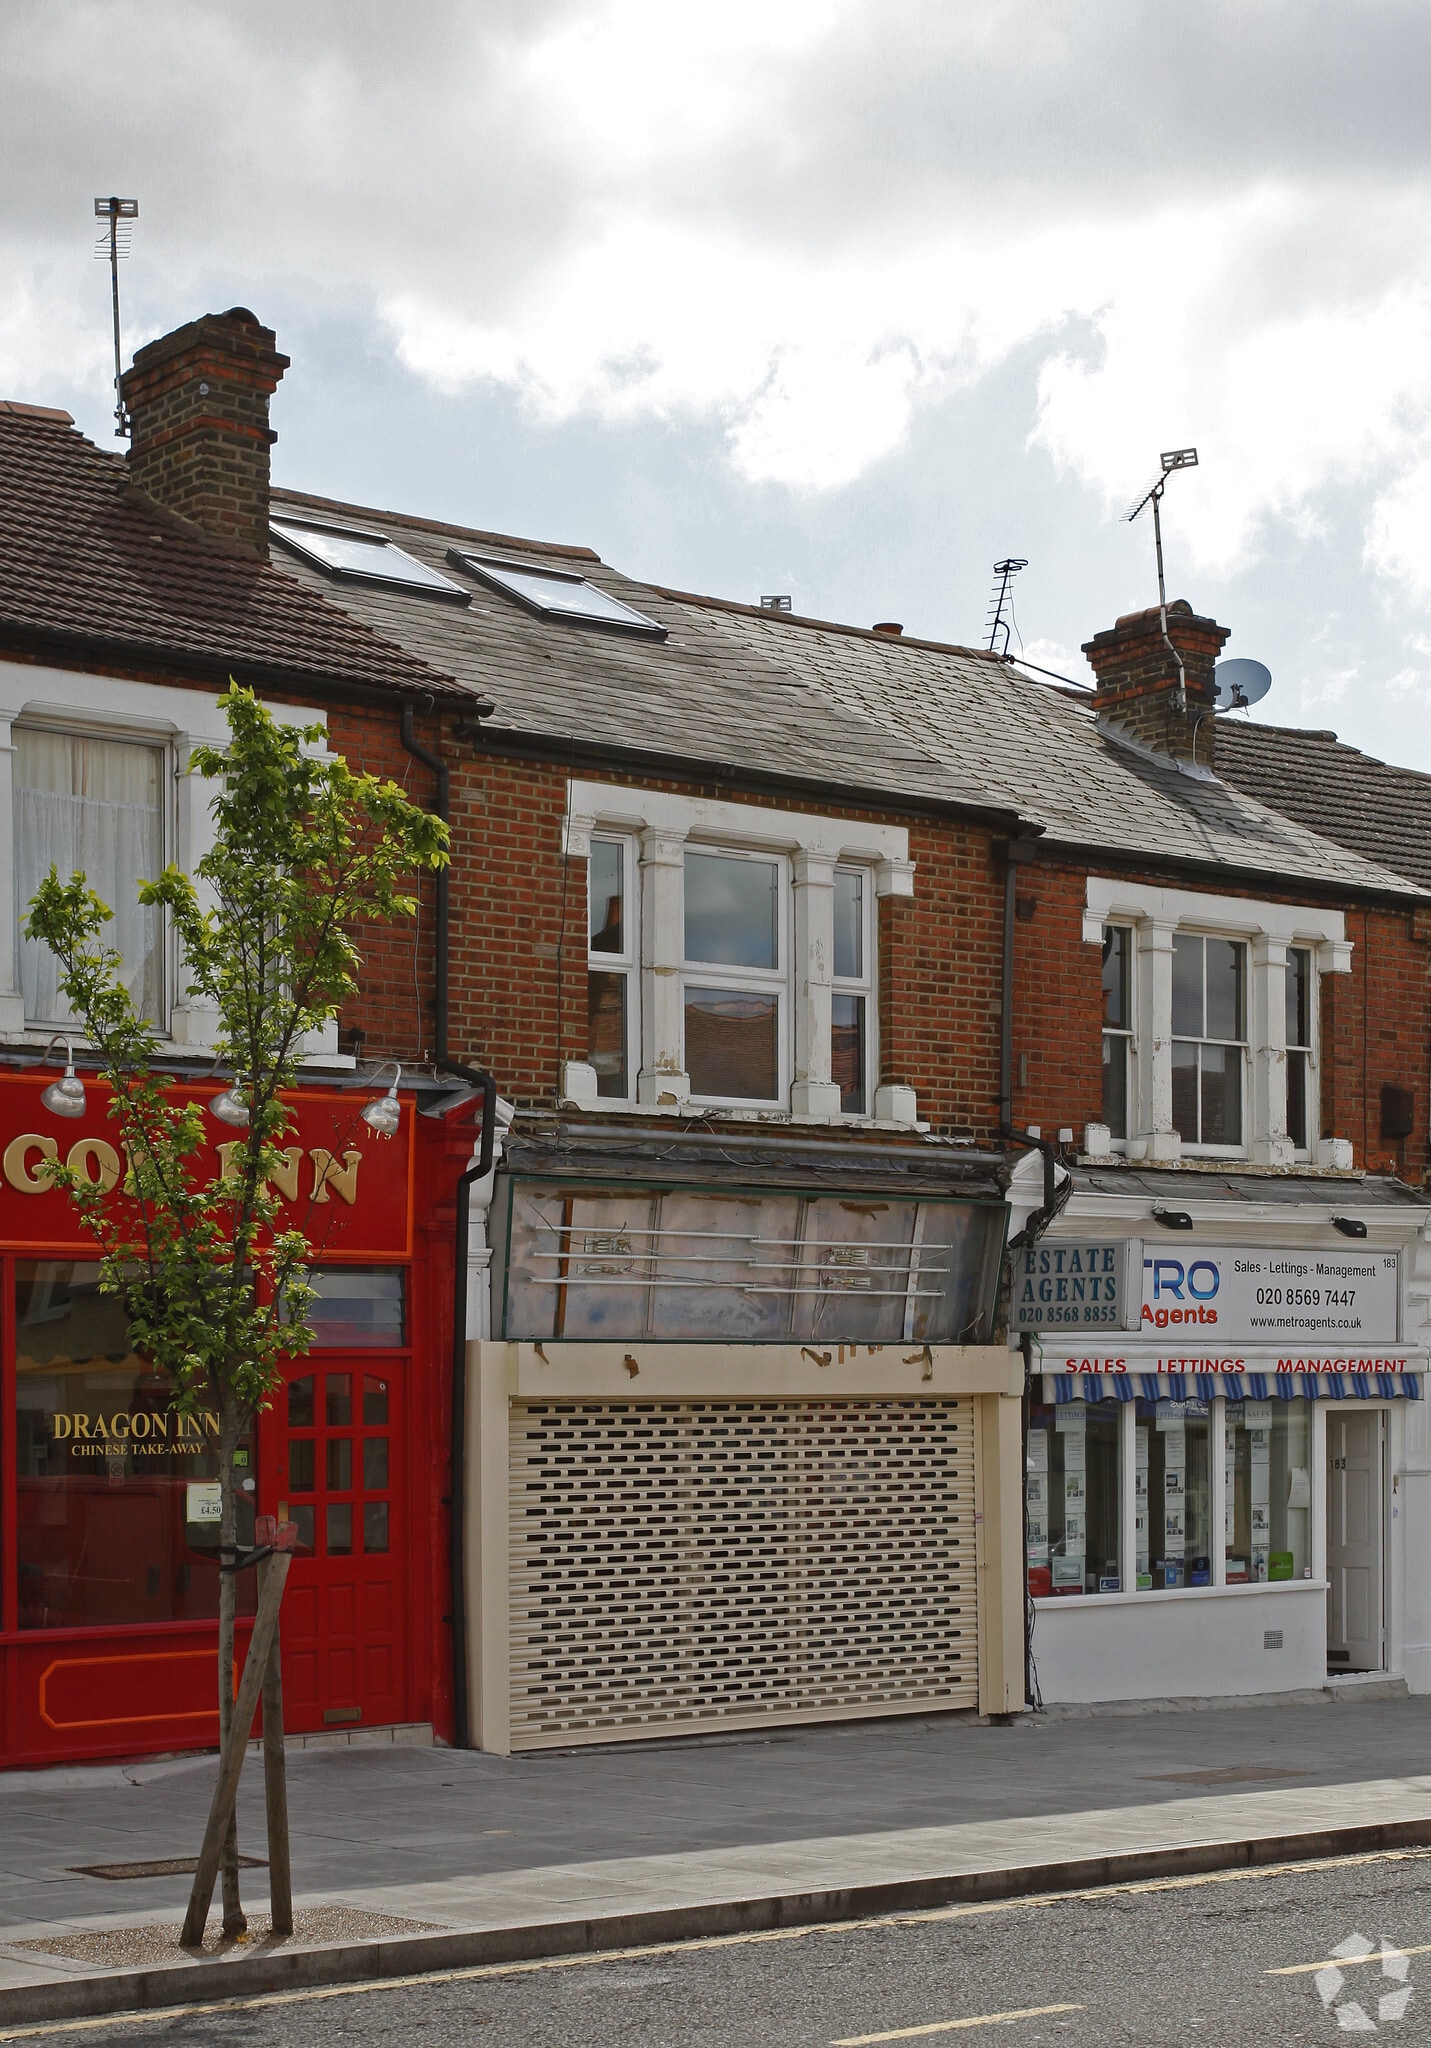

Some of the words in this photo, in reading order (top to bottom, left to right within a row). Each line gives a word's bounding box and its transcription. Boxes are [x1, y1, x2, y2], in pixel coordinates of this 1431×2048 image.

[0, 1133, 176, 1197] GO
[214, 1140, 363, 1205] INN
[1024, 1248, 1115, 1274] ESTATE
[1234, 1260, 1261, 1273] Sales
[1269, 1261, 1308, 1277] Lettings
[1316, 1263, 1376, 1279] Management
[1382, 1258, 1396, 1269] 183
[1021, 1276, 1116, 1302] AGENTS
[1256, 1287, 1282, 1305] 020
[1286, 1288, 1320, 1306] 8569
[1324, 1289, 1356, 1307] 7447
[1019, 1307, 1043, 1323] 020
[1047, 1306, 1079, 1322] 8568
[1084, 1305, 1117, 1322] 8855
[1141, 1303, 1218, 1328] Agents
[1250, 1316, 1362, 1331] www.metroagents.co.uk
[1065, 1358, 1127, 1374] SALES
[1157, 1358, 1246, 1374] LETTINGS
[1276, 1358, 1407, 1374] MANAGEMENT
[1247, 1410, 1270, 1418] SALES
[53, 1412, 169, 1439] DRAGON
[175, 1412, 220, 1437] INN
[71, 1444, 128, 1457] CHINESE
[131, 1443, 204, 1456] TAKE-AWAY
[1330, 1458, 1347, 1470] 183
[201, 1506, 221, 1515] £4.50
